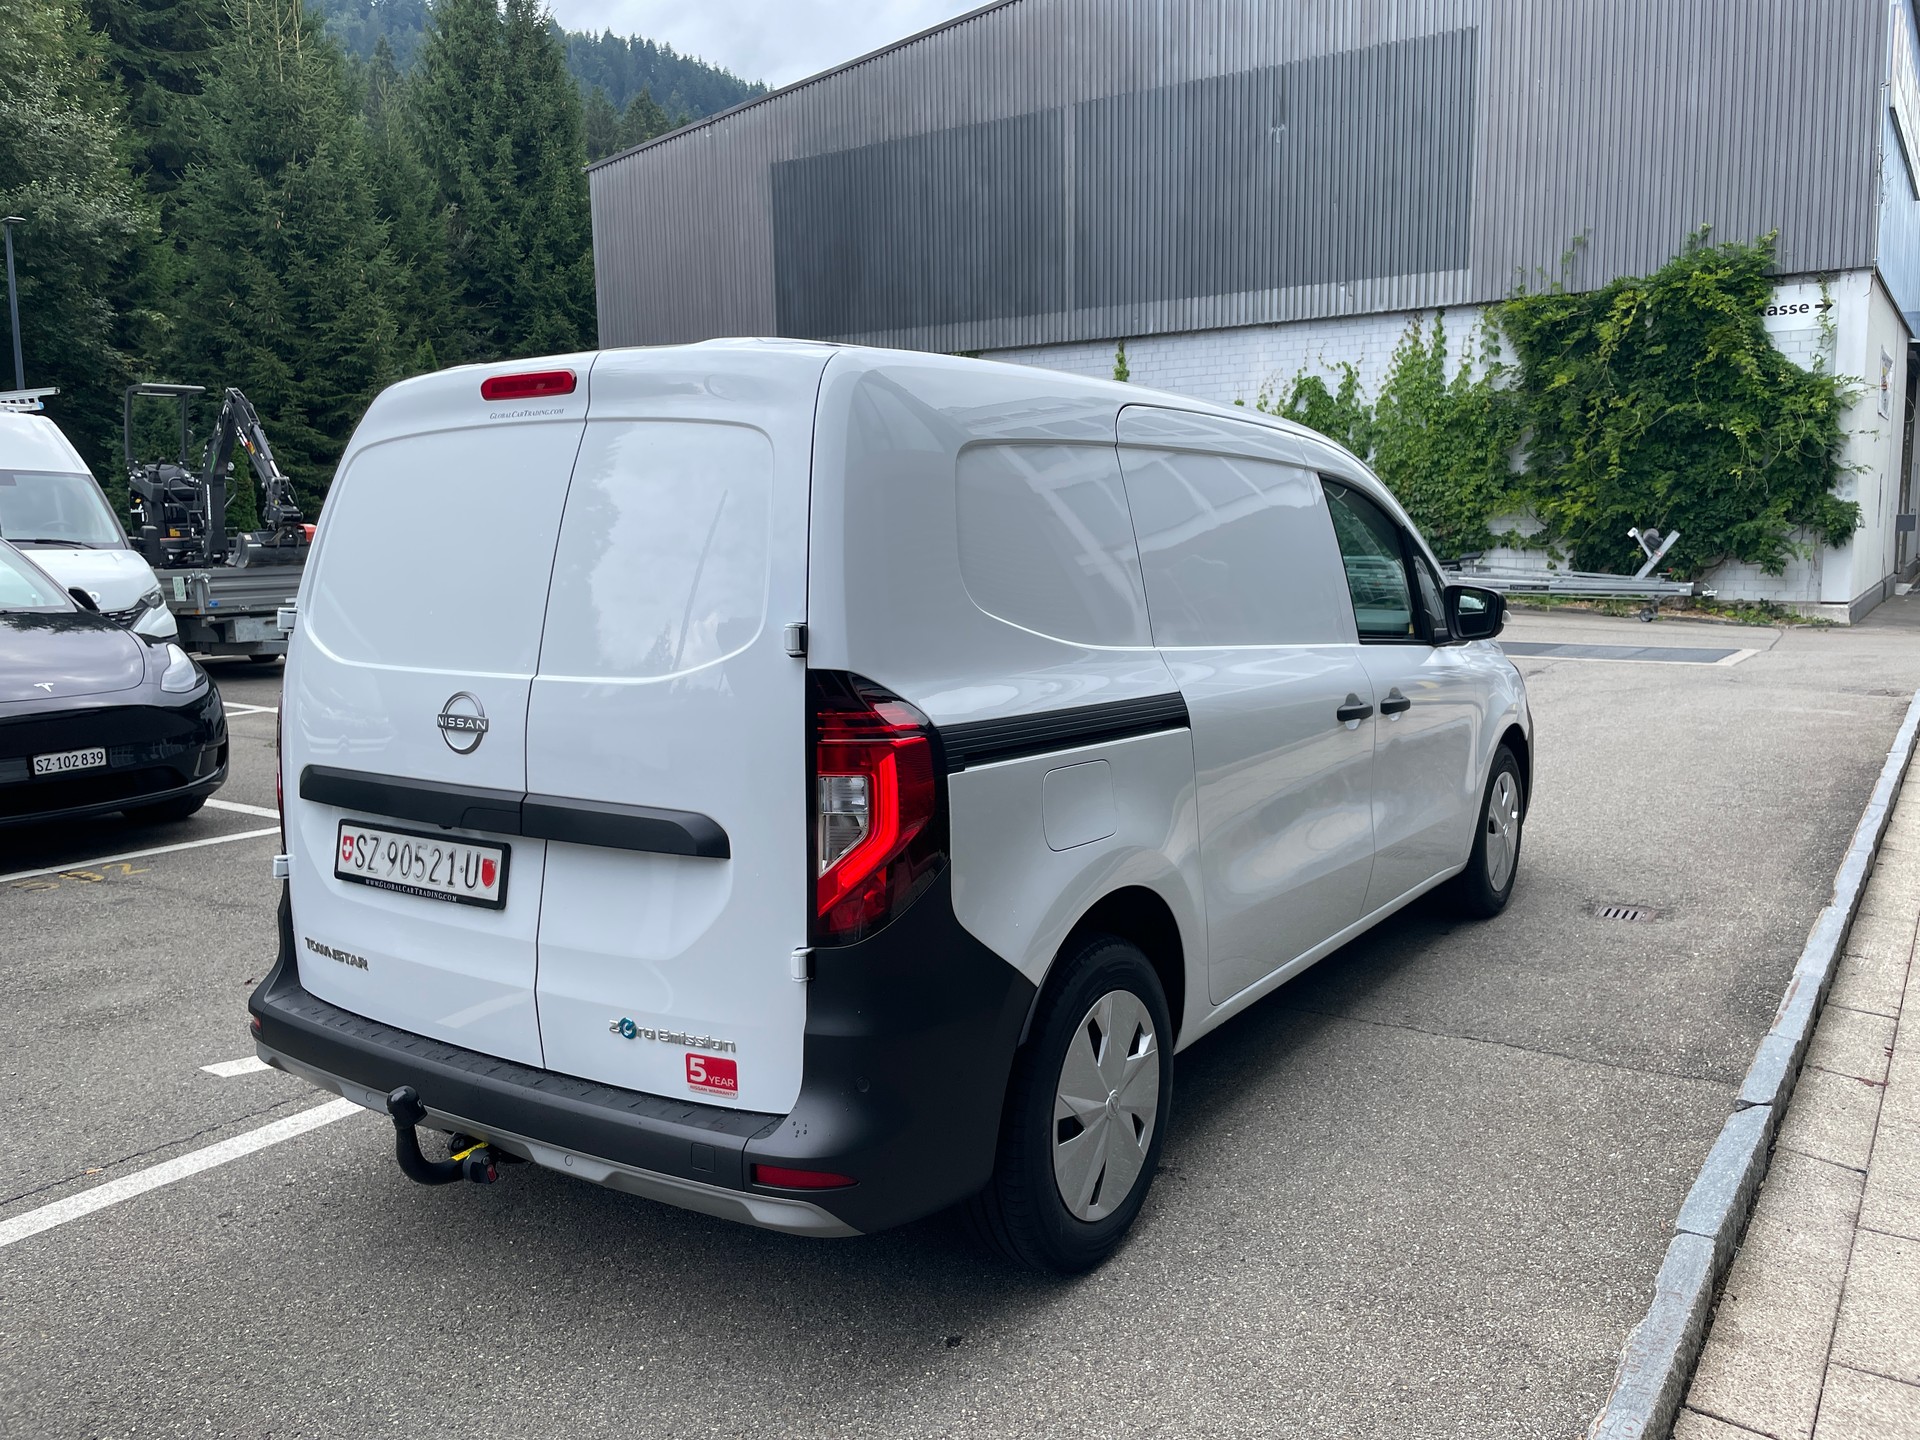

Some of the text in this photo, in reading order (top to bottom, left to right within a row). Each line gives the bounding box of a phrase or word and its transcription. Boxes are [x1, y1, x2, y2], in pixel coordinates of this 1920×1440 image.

[438, 716, 486, 730] NISSAN
[81, 751, 103, 766] 839
[305, 936, 369, 971] TOWNSTAR
[658, 1028, 736, 1053] Emission
[690, 1057, 735, 1088] 5 YEAR
[690, 1084, 736, 1097] NISSAN WARRANTY
